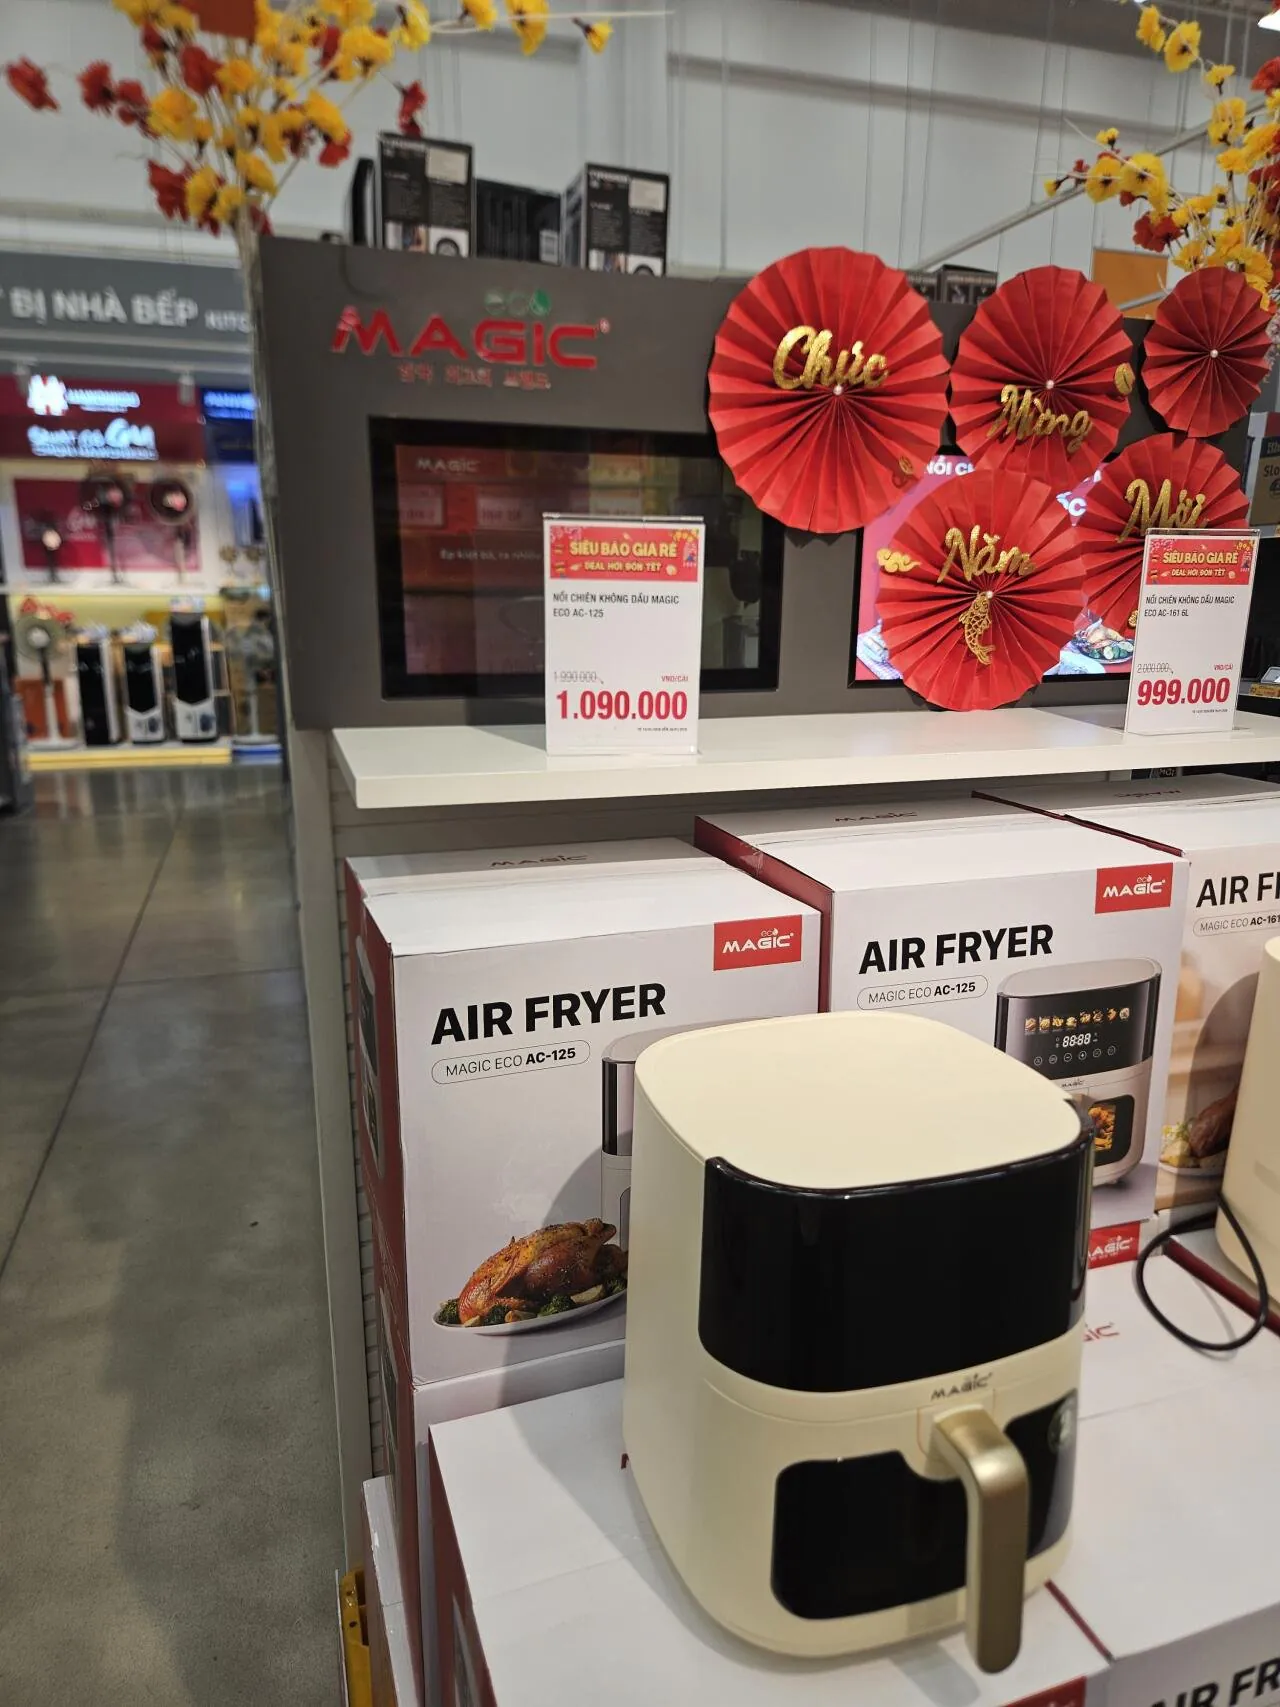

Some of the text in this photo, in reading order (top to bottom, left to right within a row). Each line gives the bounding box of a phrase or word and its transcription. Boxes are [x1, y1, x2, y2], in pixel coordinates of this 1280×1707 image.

[52, 285, 128, 324] NHÀ
[131, 285, 198, 327] BẾP
[332, 304, 598, 369] MAGIC
[569, 539, 600, 557] SIÊU
[936, 524, 1038, 583] Năm
[1163, 550, 1183, 564] SIÊU
[600, 592, 629, 604] KHÔNG
[651, 595, 679, 605] MAGIC
[1214, 596, 1235, 604] MAGIC
[553, 607, 604, 618] ECO AC-125
[1144, 609, 1158, 617] ECO
[1158, 609, 1180, 617] AC-161
[1136, 677, 1231, 706] 999.000
[556, 689, 688, 721] 1.090.000
[1102, 881, 1164, 898] MAGIC
[1195, 875, 1249, 908] AIR
[1200, 919, 1229, 932] MAGIC
[1230, 917, 1249, 929] ECO
[722, 934, 792, 954] MAGIC
[858, 924, 1054, 975] AIR FRYER
[868, 981, 976, 1004] MAGIC ECO AC-125
[431, 982, 667, 1046] AIR FRYER
[446, 1047, 576, 1078] MAGIC ECO AC-125
[1088, 1238, 1131, 1257] AGIC
[931, 1374, 990, 1402] MAGIC
